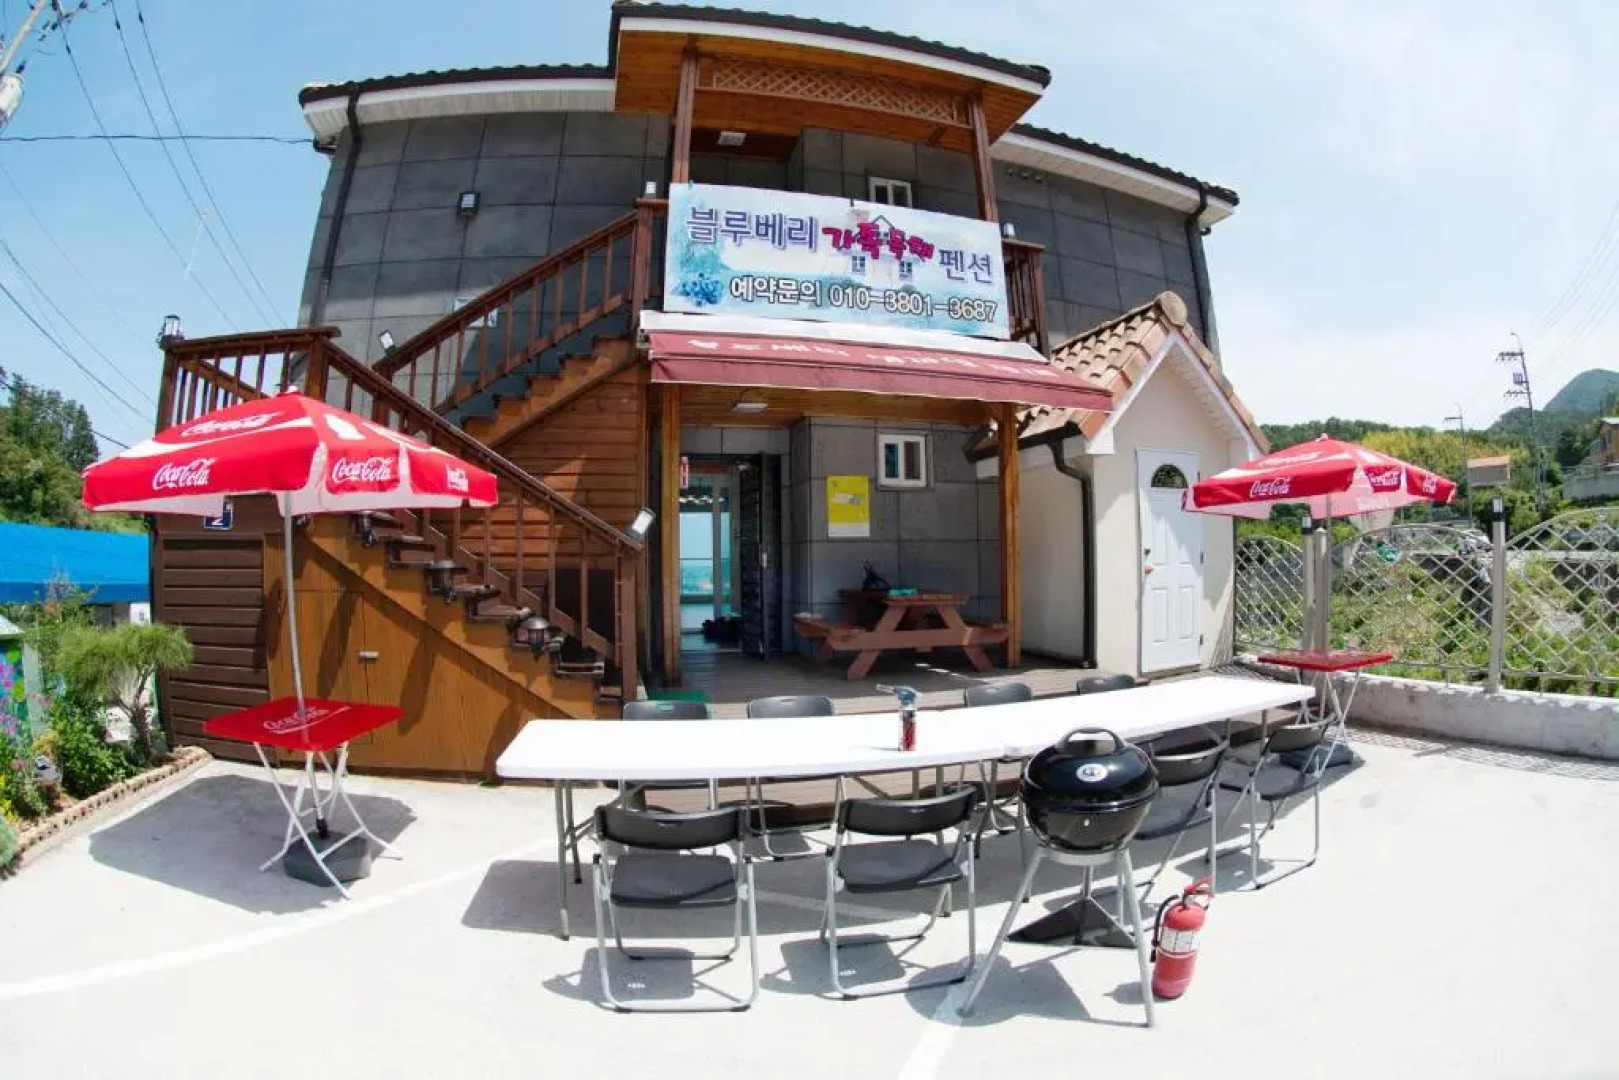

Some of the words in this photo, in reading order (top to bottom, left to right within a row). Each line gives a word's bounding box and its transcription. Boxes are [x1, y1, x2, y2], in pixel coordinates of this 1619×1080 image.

[686, 205, 818, 252] 블루베리
[938, 249, 993, 284] 펜션
[730, 275, 820, 306] 예약문의
[829, 284, 998, 322] 010-3801-3687
[332, 456, 394, 482] Coca-Cola
